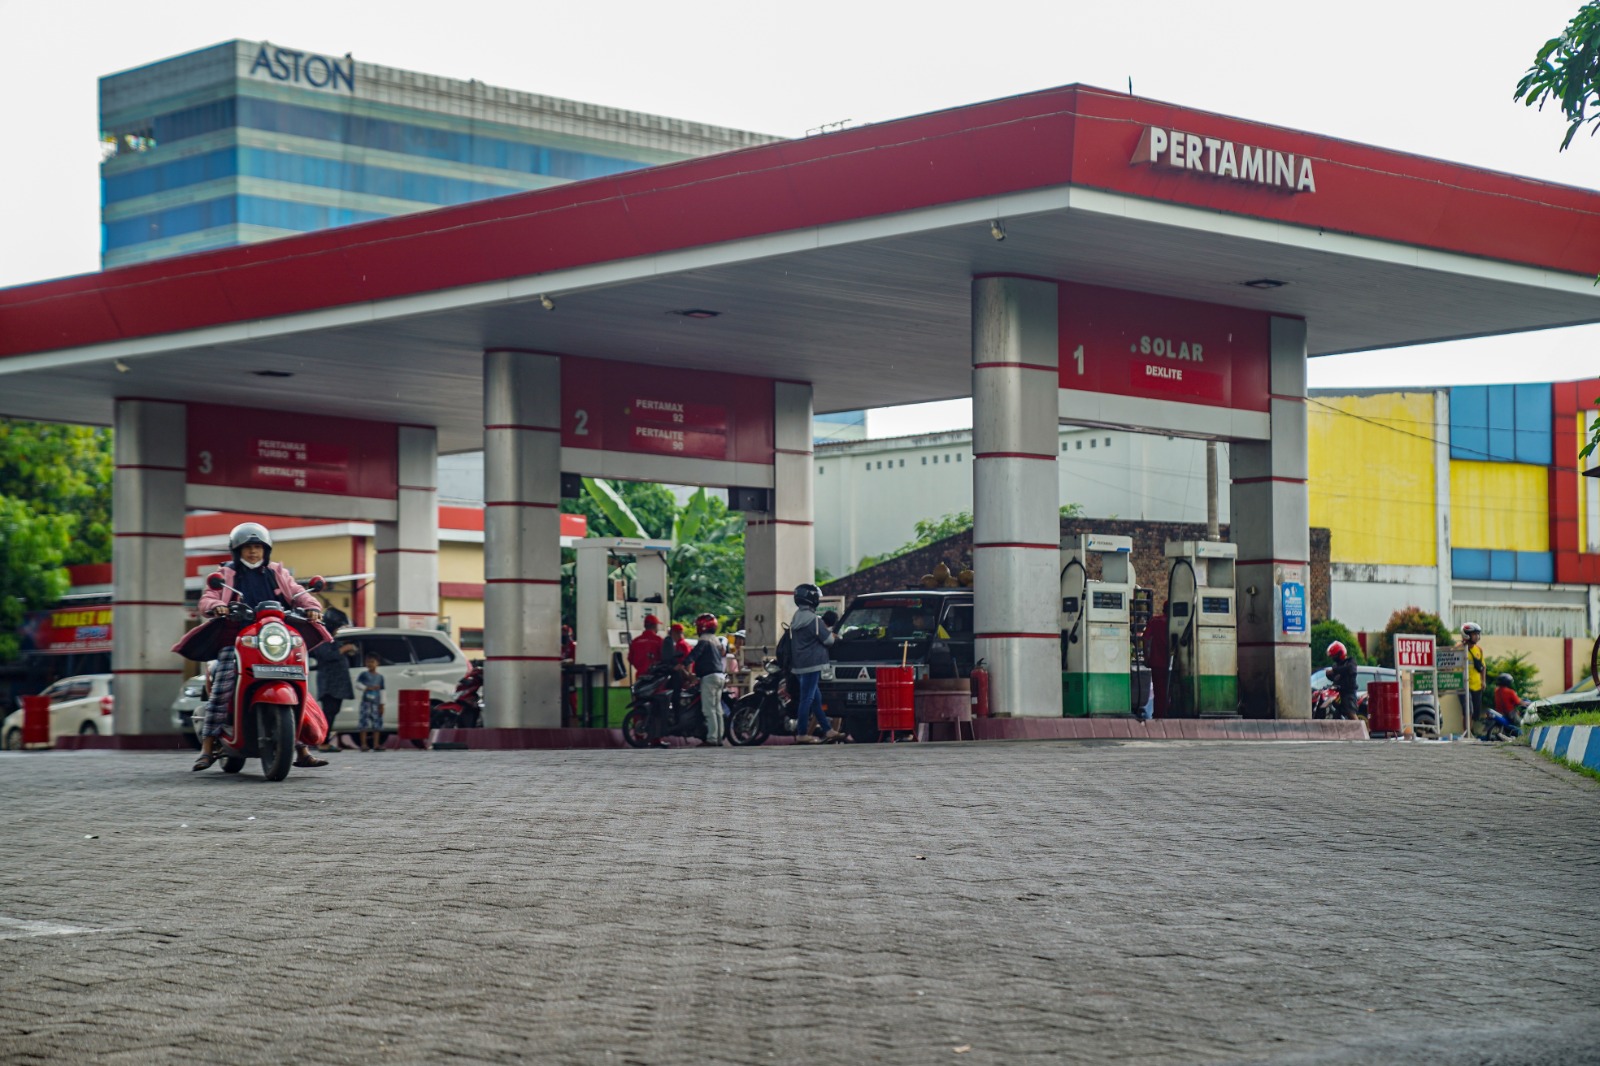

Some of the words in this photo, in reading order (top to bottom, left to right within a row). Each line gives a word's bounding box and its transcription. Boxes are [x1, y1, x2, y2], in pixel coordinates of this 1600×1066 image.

[251, 47, 354, 92] ASTON
[1150, 126, 1316, 193] PERTAMINA
[1140, 335, 1204, 362] SOLAR
[1073, 344, 1084, 376] 1
[1145, 364, 1182, 380] DEXLITE
[636, 399, 684, 412] PERTAMAX
[574, 409, 589, 436] 2
[672, 413, 684, 423] 92
[636, 426, 684, 440] PERTALITE
[258, 439, 306, 451] PERTAMAX
[258, 449, 289, 459] TURBO
[198, 450, 213, 475] 3
[258, 466, 306, 478] PERTALITE
[1398, 640, 1431, 653] LISTRIK
[1402, 653, 1428, 665] MATI
